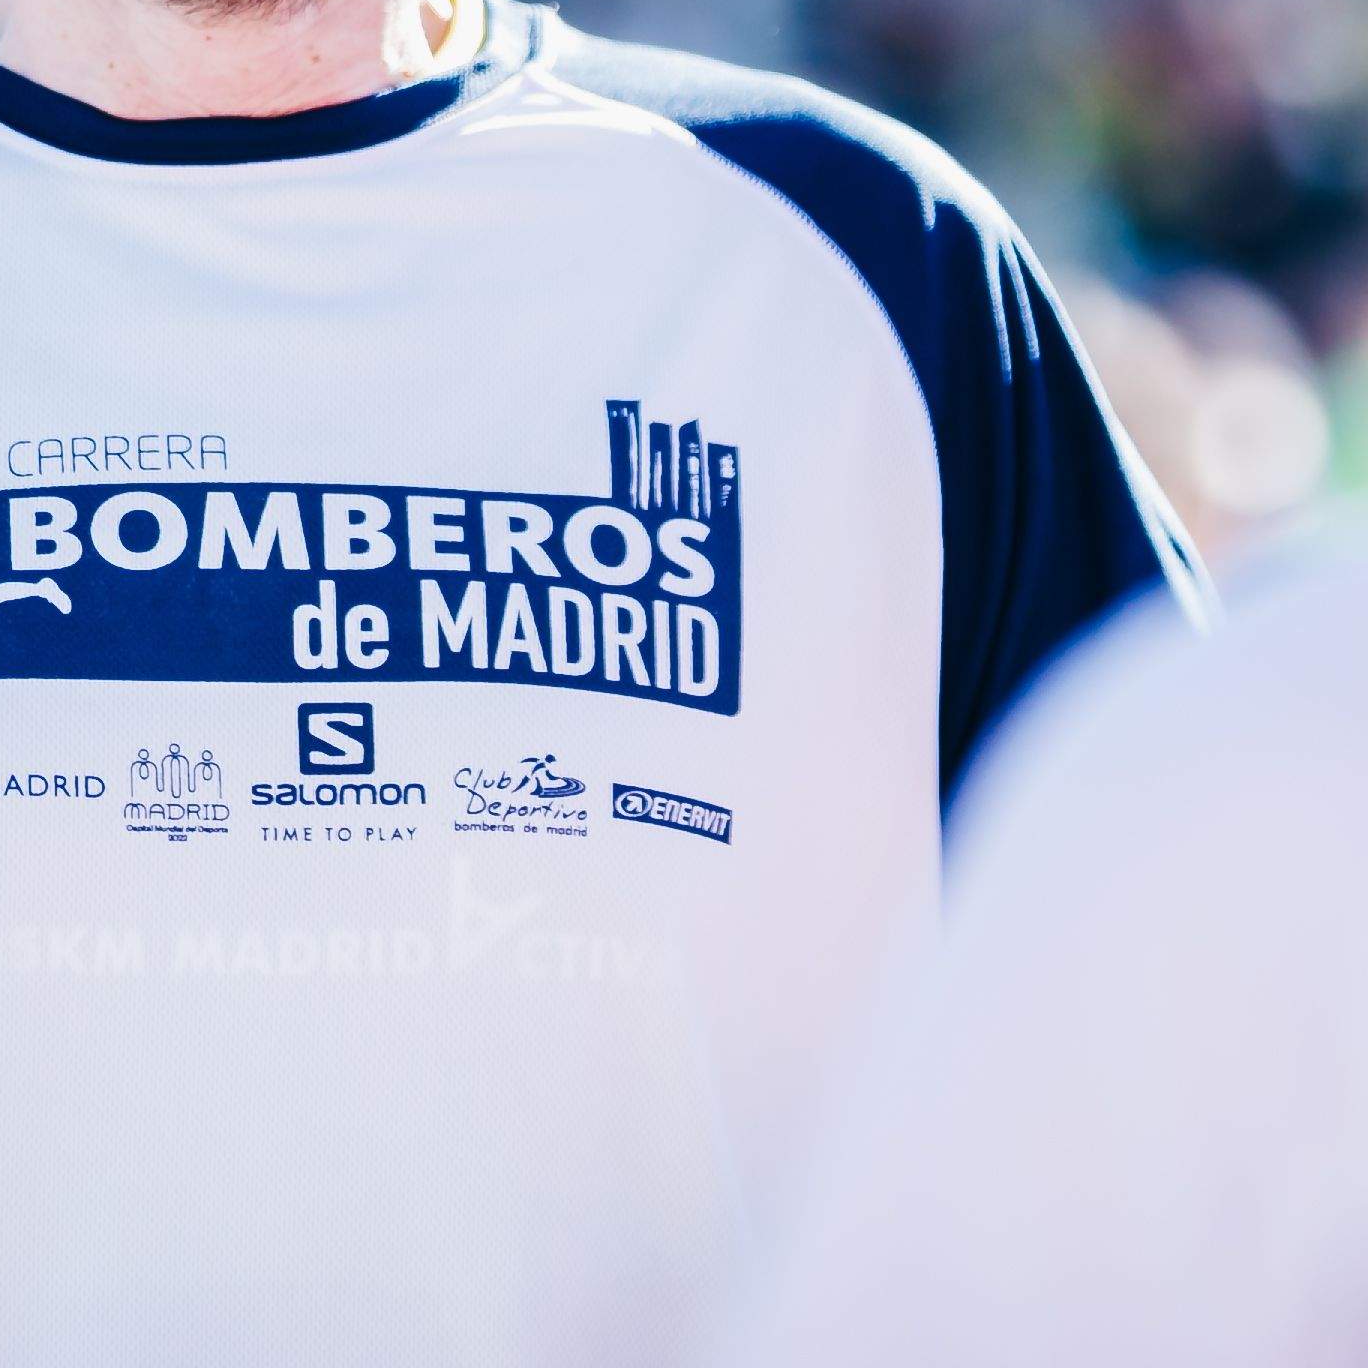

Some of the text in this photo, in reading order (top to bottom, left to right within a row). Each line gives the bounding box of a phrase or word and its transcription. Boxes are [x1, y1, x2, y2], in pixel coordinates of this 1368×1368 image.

[7, 434, 229, 477] CARRERA
[8, 490, 716, 599] BOMBEROS
[292, 579, 720, 697] de MADRID
[308, 712, 365, 766] S
[453, 767, 513, 791] Club
[123, 802, 230, 821] MADRID
[466, 787, 588, 821] Deportivo
[260, 827, 418, 842] TIME TO PLAY
[453, 819, 588, 838] bomberos de madrid
[173, 927, 432, 979] MADRID
